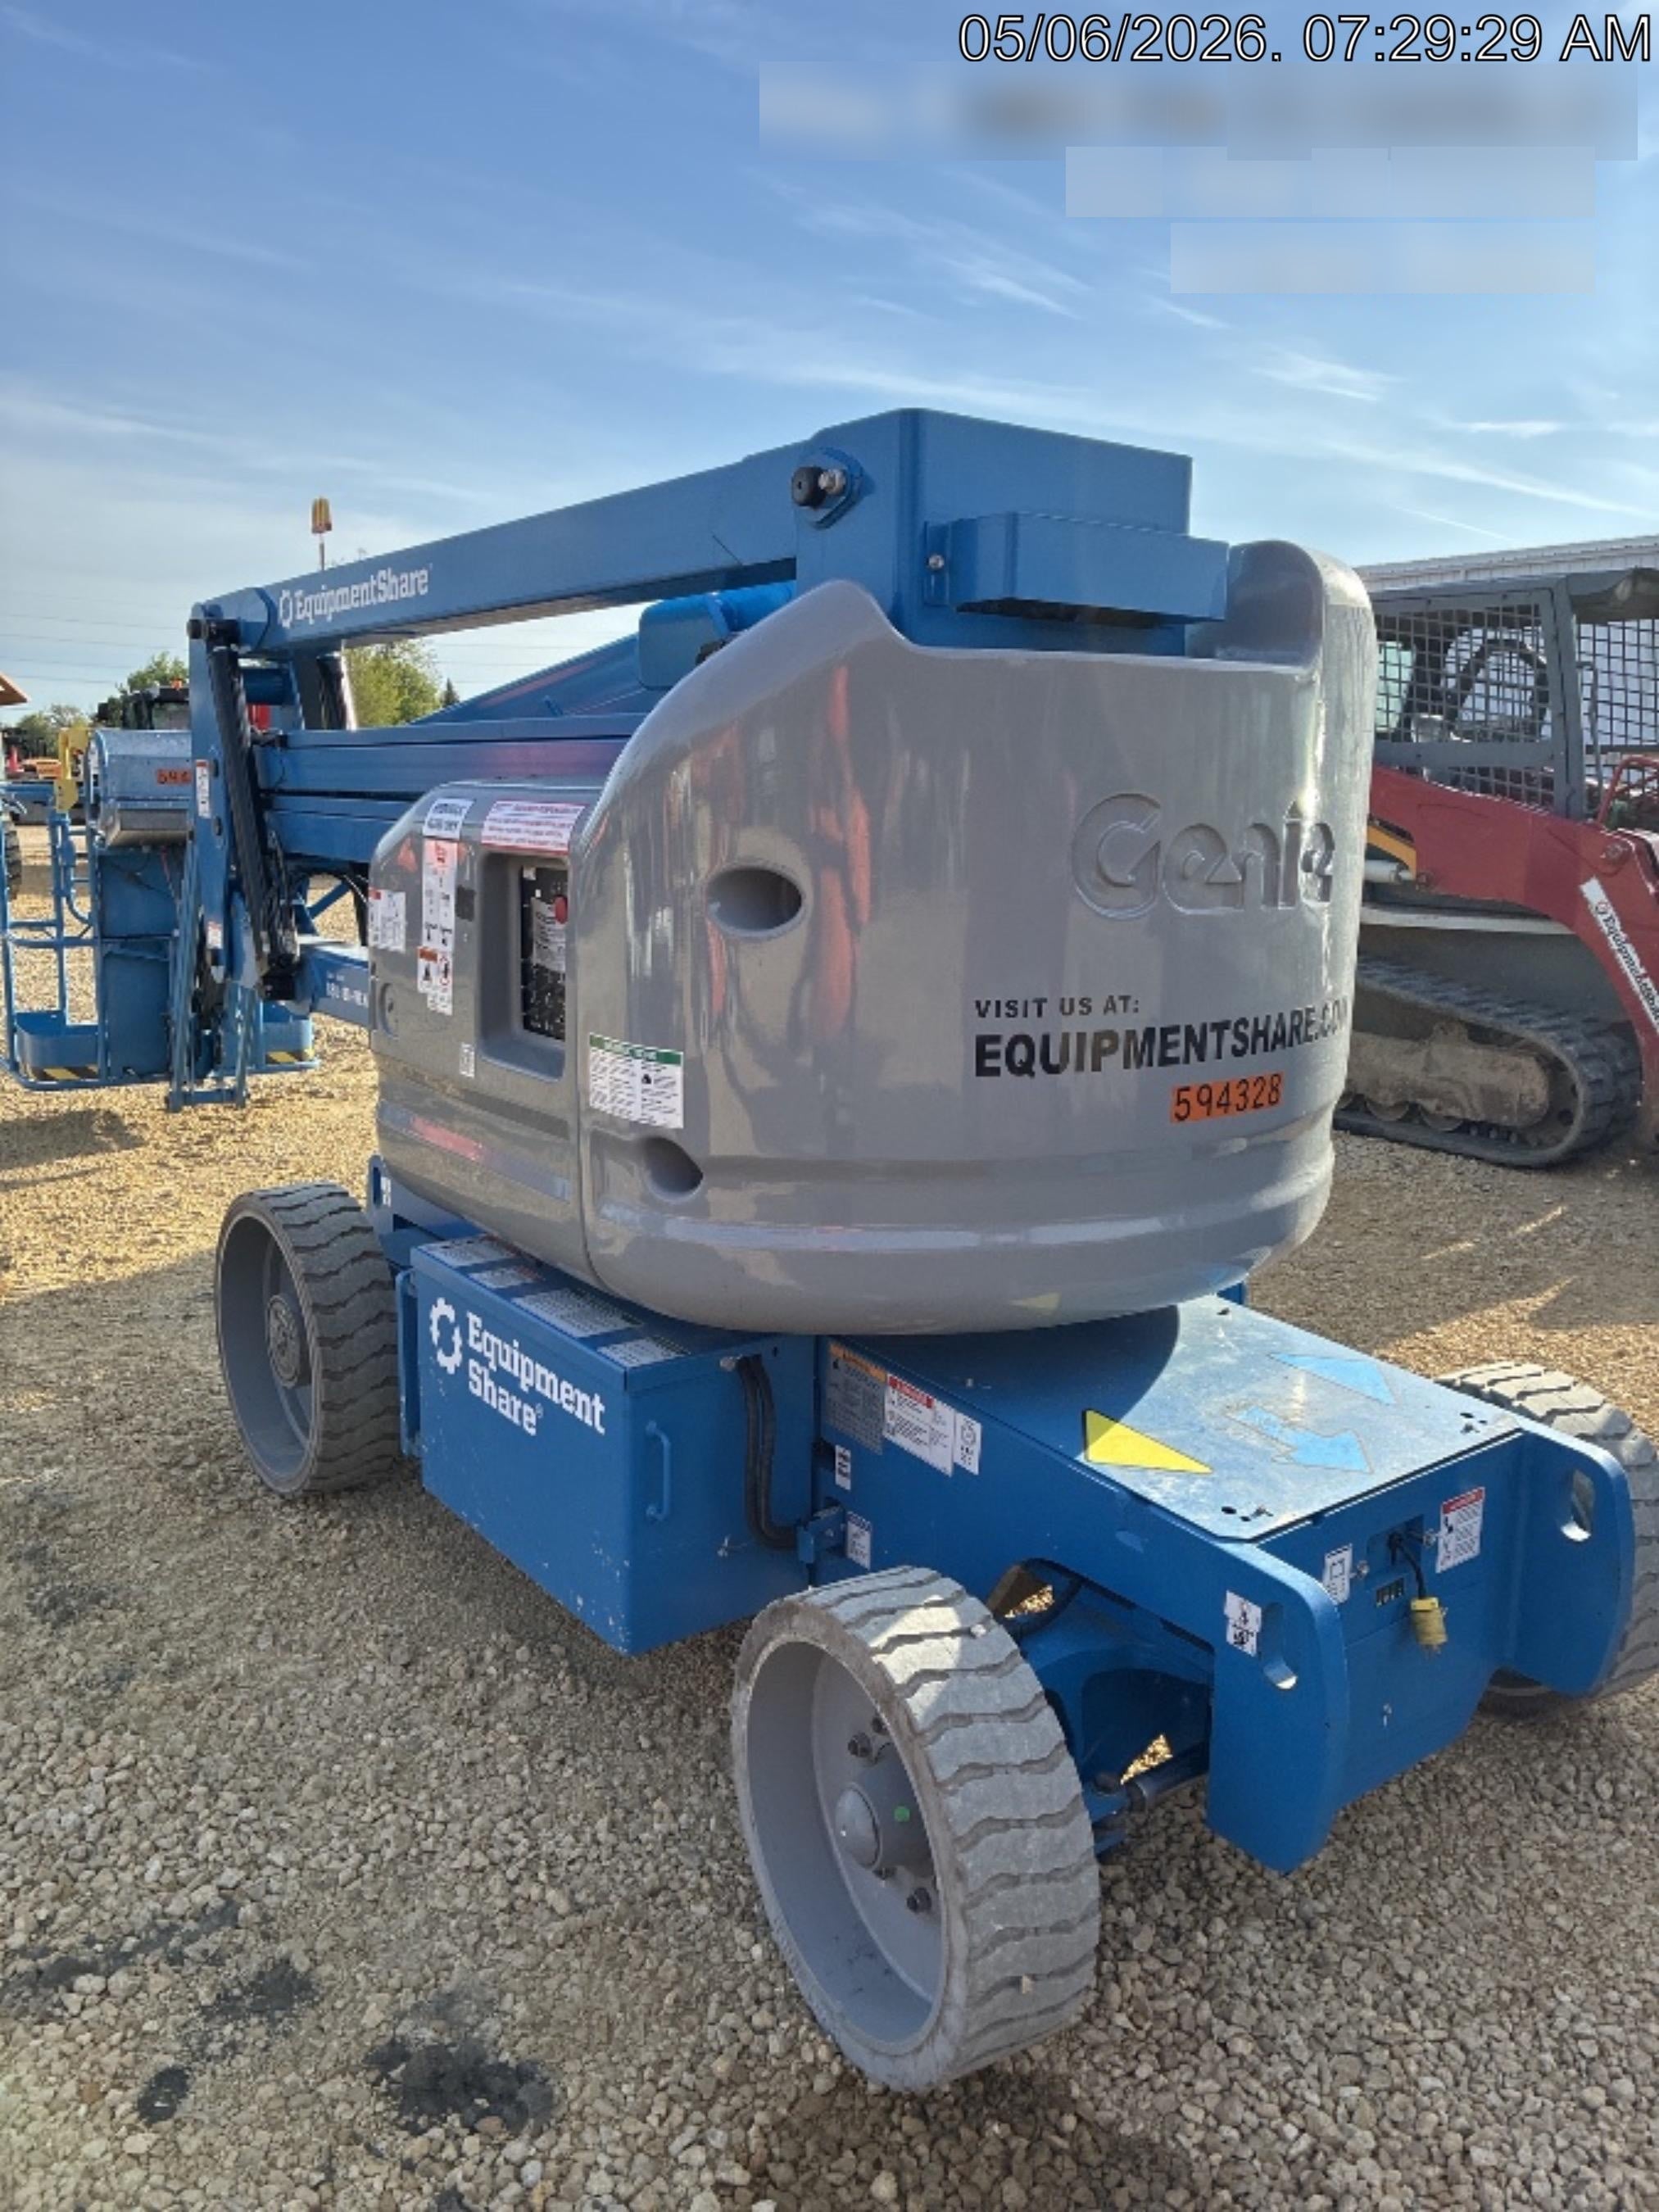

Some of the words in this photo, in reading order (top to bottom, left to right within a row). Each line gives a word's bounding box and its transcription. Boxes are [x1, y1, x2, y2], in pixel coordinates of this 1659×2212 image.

[294, 567, 429, 625] EquipmentShare
[1072, 792, 1335, 920] Genie
[975, 998, 1047, 1018] VISIT
[1059, 996, 1092, 1016] US
[1103, 995, 1140, 1015] AT:
[1174, 1073, 1283, 1122] 594328
[465, 1311, 605, 1435] Equipment
